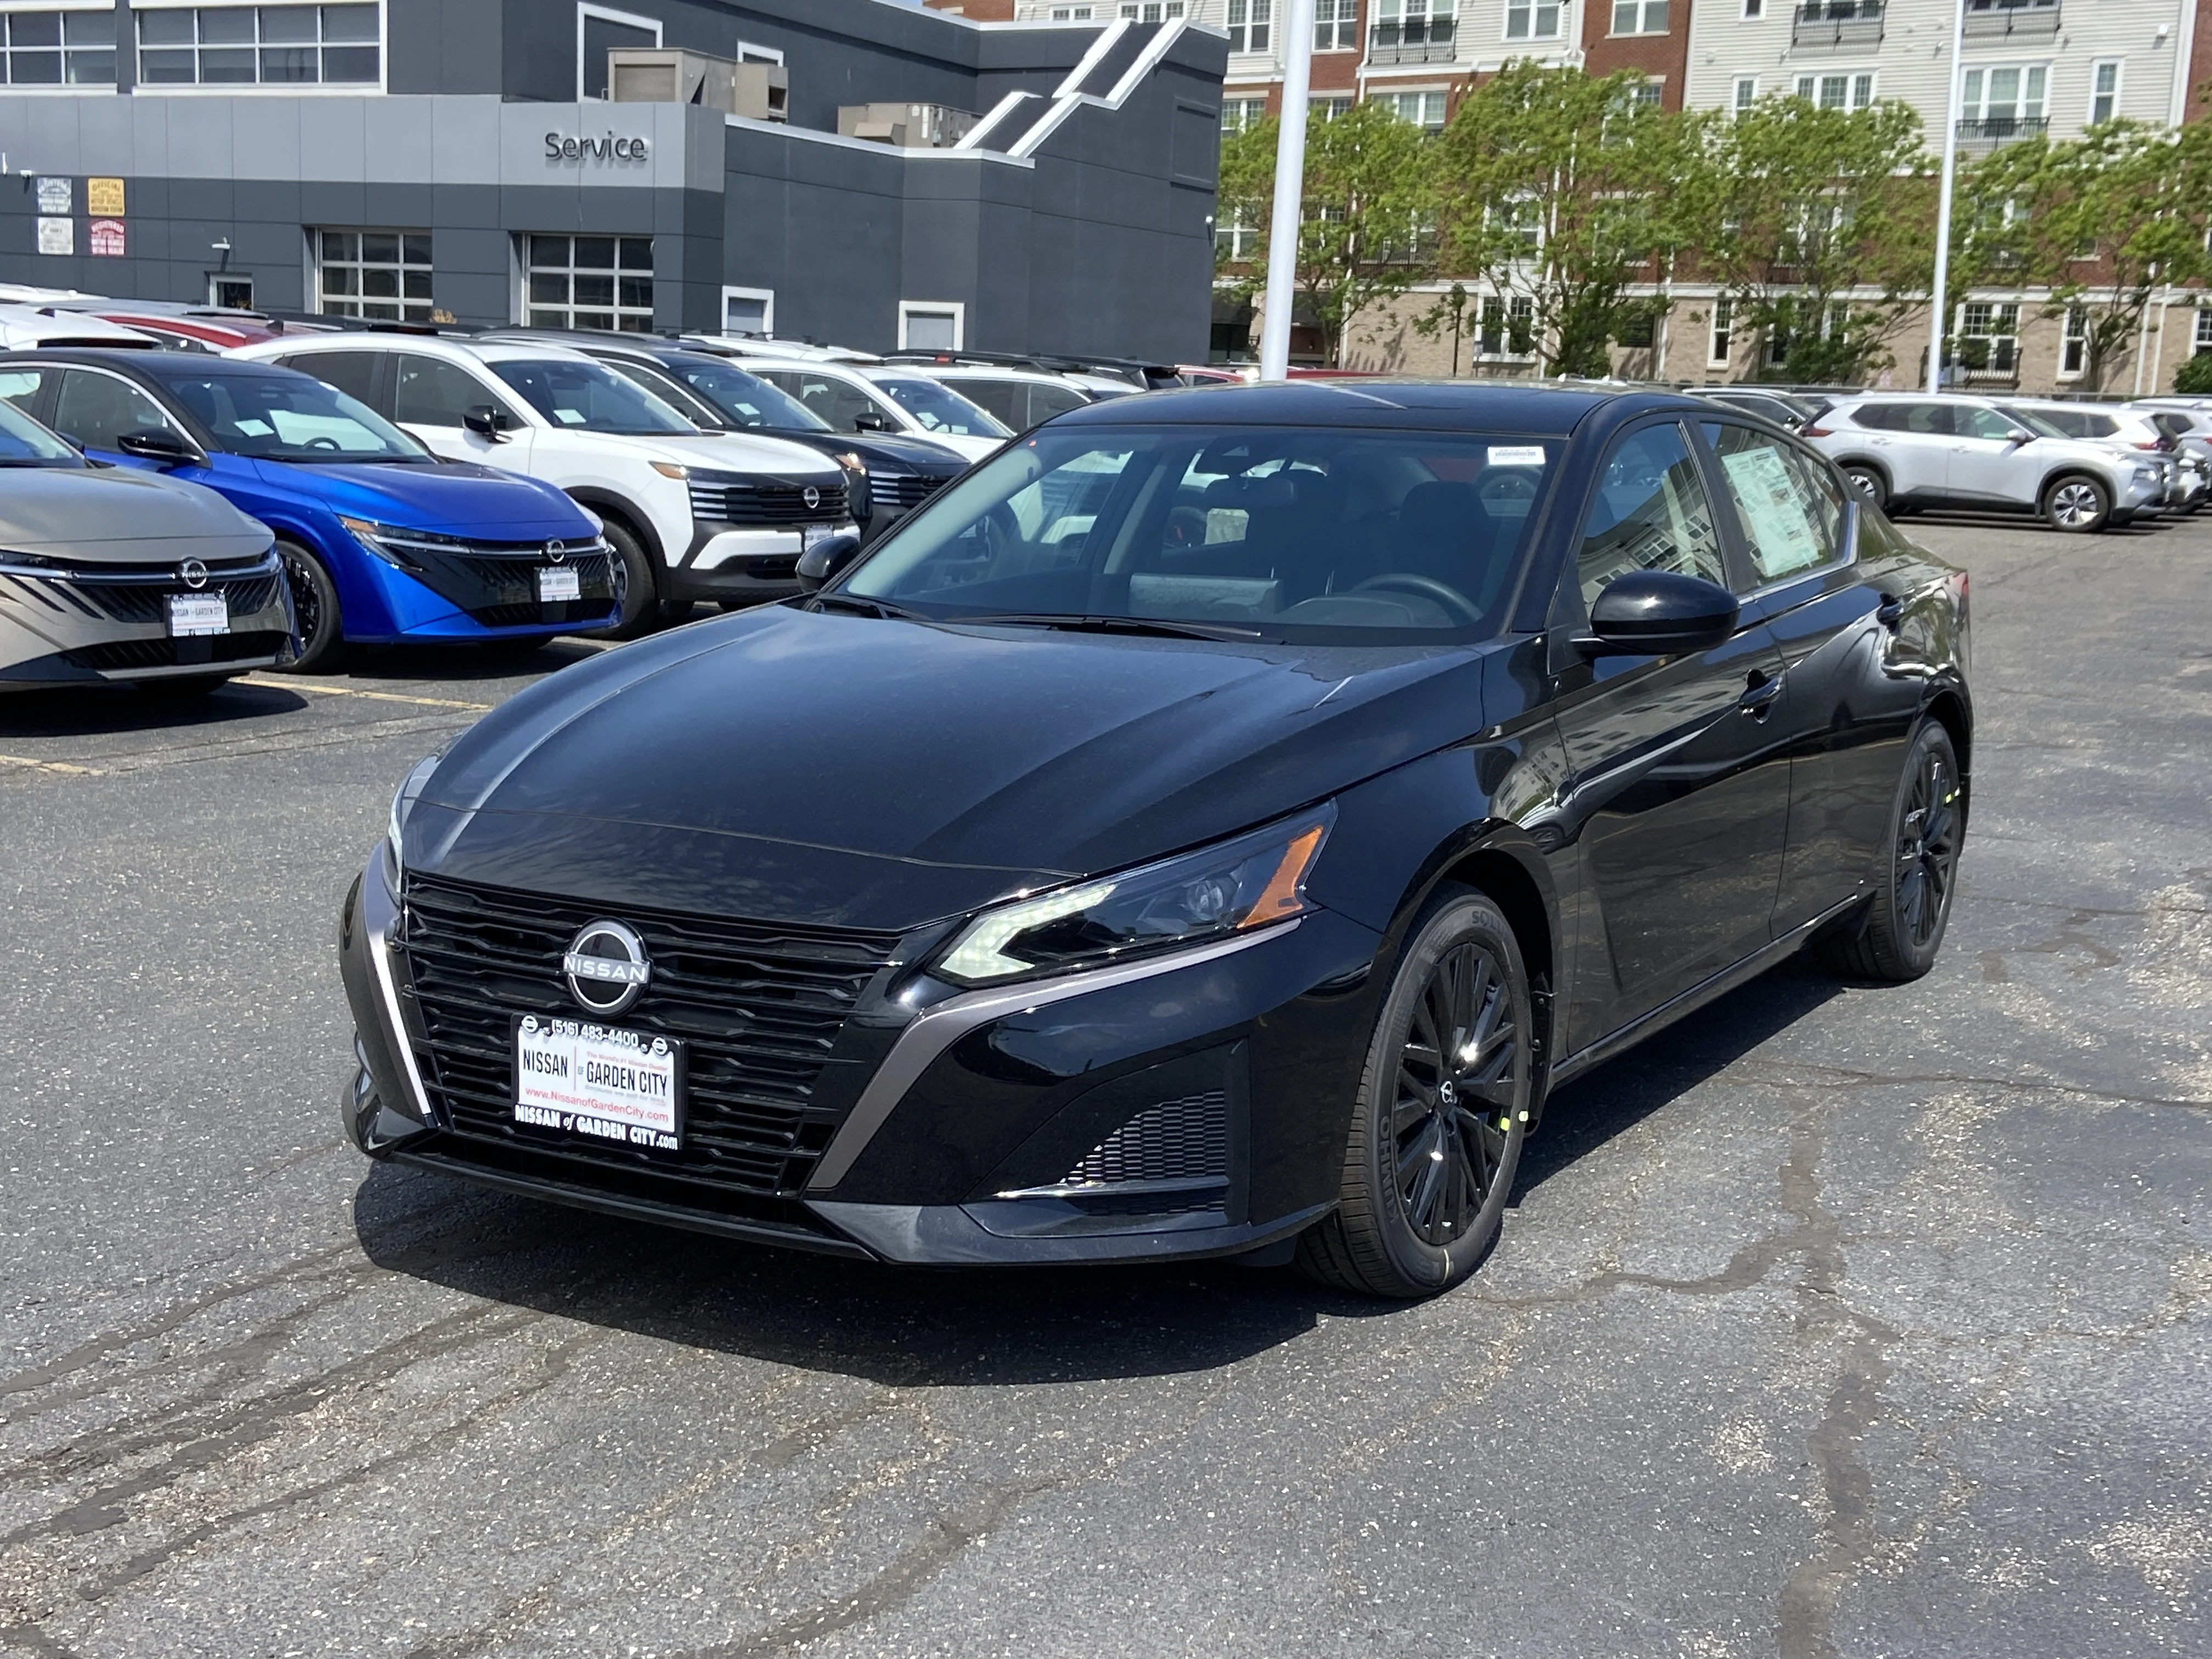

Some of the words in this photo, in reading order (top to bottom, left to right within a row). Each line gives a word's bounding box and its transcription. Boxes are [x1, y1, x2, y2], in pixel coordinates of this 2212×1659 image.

[545, 131, 647, 161] Service
[564, 956, 646, 981] NISSAN
[552, 1019, 578, 1036] (516)
[581, 1024, 639, 1047] 483-4400
[523, 1048, 568, 1078] NISSAN
[587, 1060, 635, 1091] GARDEN
[639, 1070, 668, 1097] CITY
[525, 1088, 669, 1122] www.NissanofGardenCity.com
[515, 1104, 561, 1128] NISSAN
[563, 1114, 575, 1131] of
[577, 1115, 627, 1141] GARDEN
[1380, 1116, 1400, 1225] KUMHO
